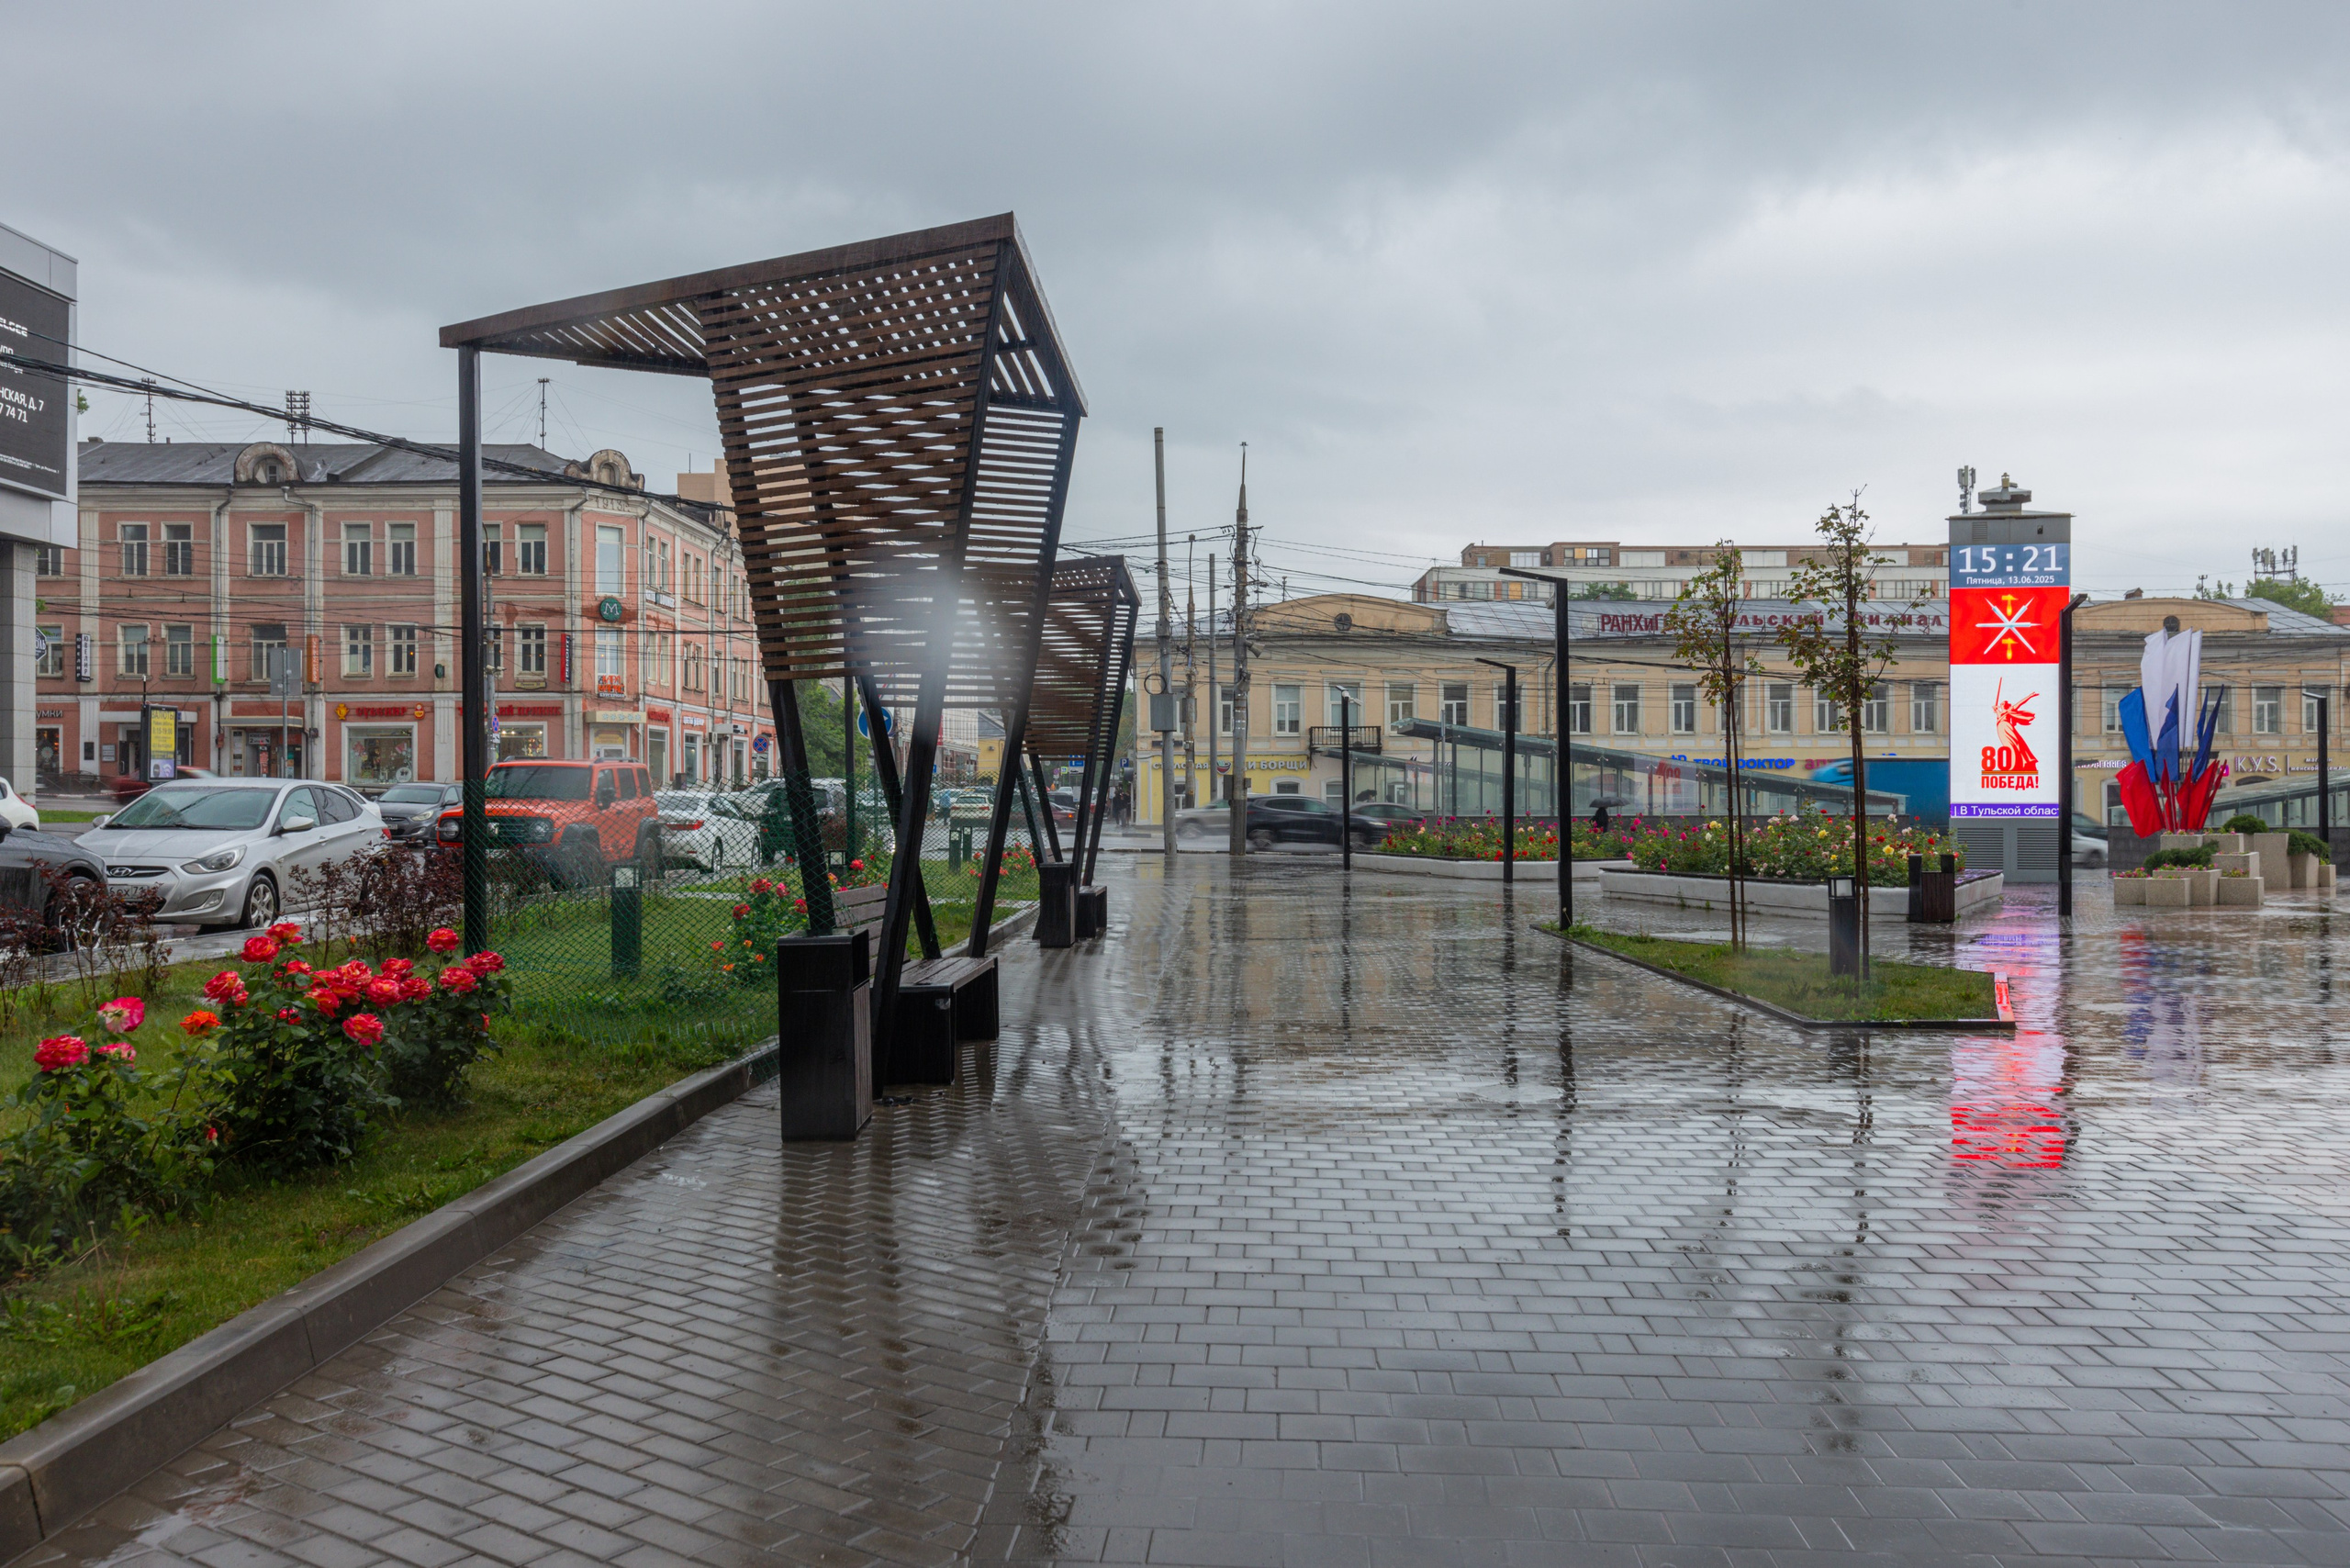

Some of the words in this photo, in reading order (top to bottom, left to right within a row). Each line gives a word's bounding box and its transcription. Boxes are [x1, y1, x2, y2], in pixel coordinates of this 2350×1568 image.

[39, 399, 44, 411] 7
[6, 405, 16, 419] 74
[17, 409, 28, 423] 71
[1959, 545, 2063, 573] 15:21
[1966, 577, 2006, 585] Пятница,
[2009, 576, 2054, 584] 13.06.2025
[1981, 746, 2012, 771] 80
[1259, 761, 1307, 771] БОРЩИ
[1981, 776, 2039, 790] ПОБЕДА!
[1960, 806, 1968, 815] В
[1971, 805, 2021, 816] Тульской
